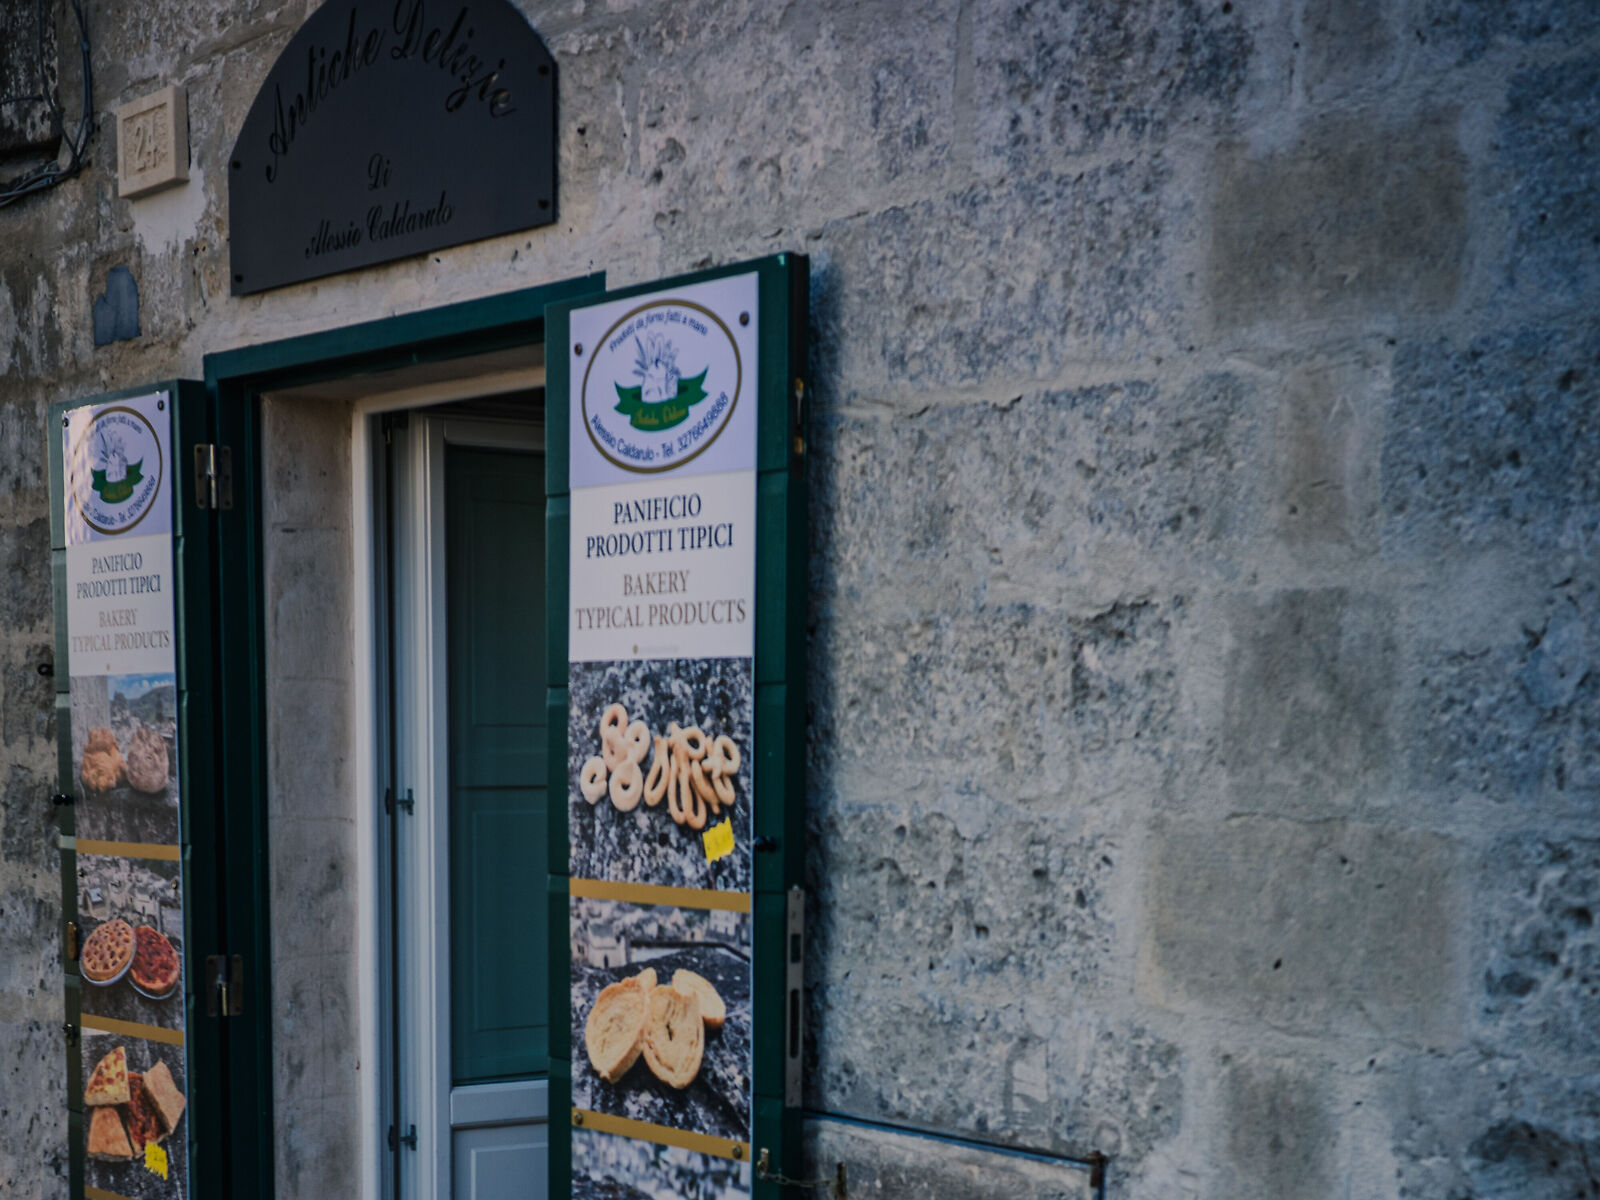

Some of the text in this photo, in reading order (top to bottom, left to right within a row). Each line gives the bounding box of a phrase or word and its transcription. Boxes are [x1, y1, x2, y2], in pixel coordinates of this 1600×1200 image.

[266, 0, 517, 183] Antiche Delizie
[367, 153, 391, 190] Di
[305, 190, 453, 258] Alessio Caldarulo
[591, 413, 616, 448] Alessio
[614, 493, 702, 524] PANIFICIO
[586, 523, 734, 558] PRODOTTI TIPICI
[92, 552, 143, 574] PANIFICIO
[76, 574, 161, 599] PRODOTTI TIPICI
[623, 570, 690, 597] BAKERY
[99, 608, 138, 628] BAKERY
[576, 599, 747, 630] TYPICAL PRODUCTS
[72, 630, 170, 653] TYPICAL PRODUCTS
